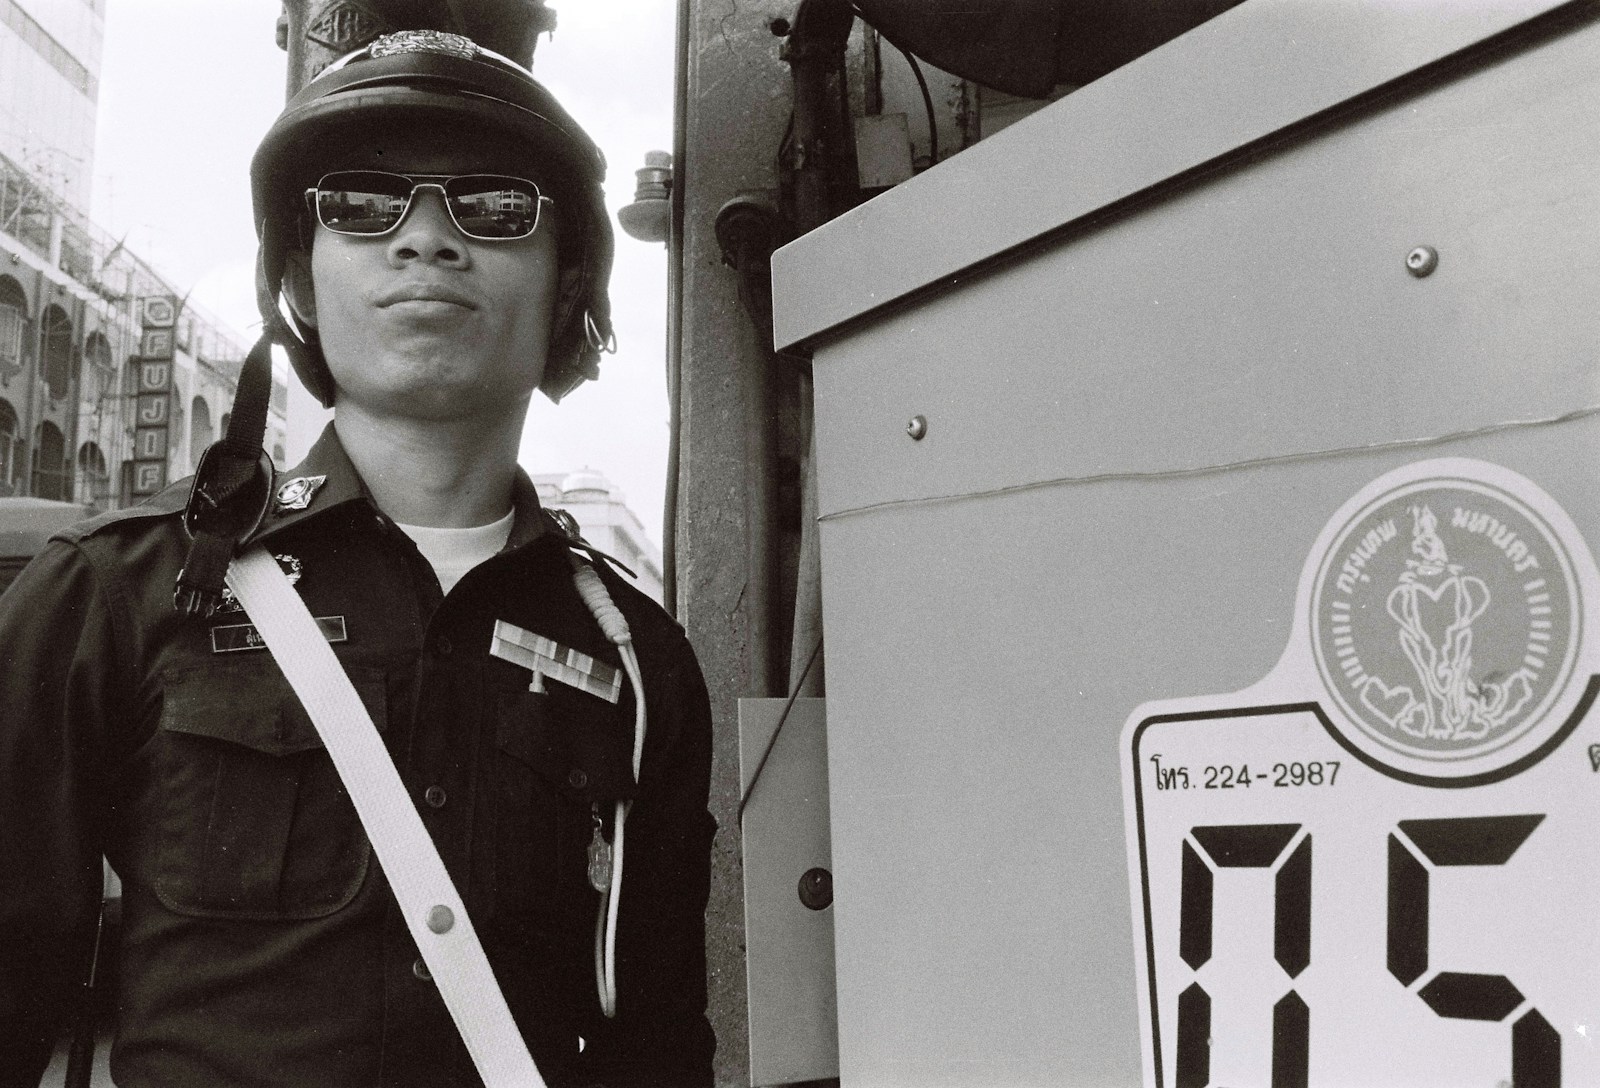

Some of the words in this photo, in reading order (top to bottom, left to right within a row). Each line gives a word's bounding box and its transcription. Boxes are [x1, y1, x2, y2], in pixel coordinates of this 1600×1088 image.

[1450, 506, 1540, 573] มหานคร
[1150, 754, 1196, 791] โทร.
[1204, 760, 1341, 790] 224-2987
